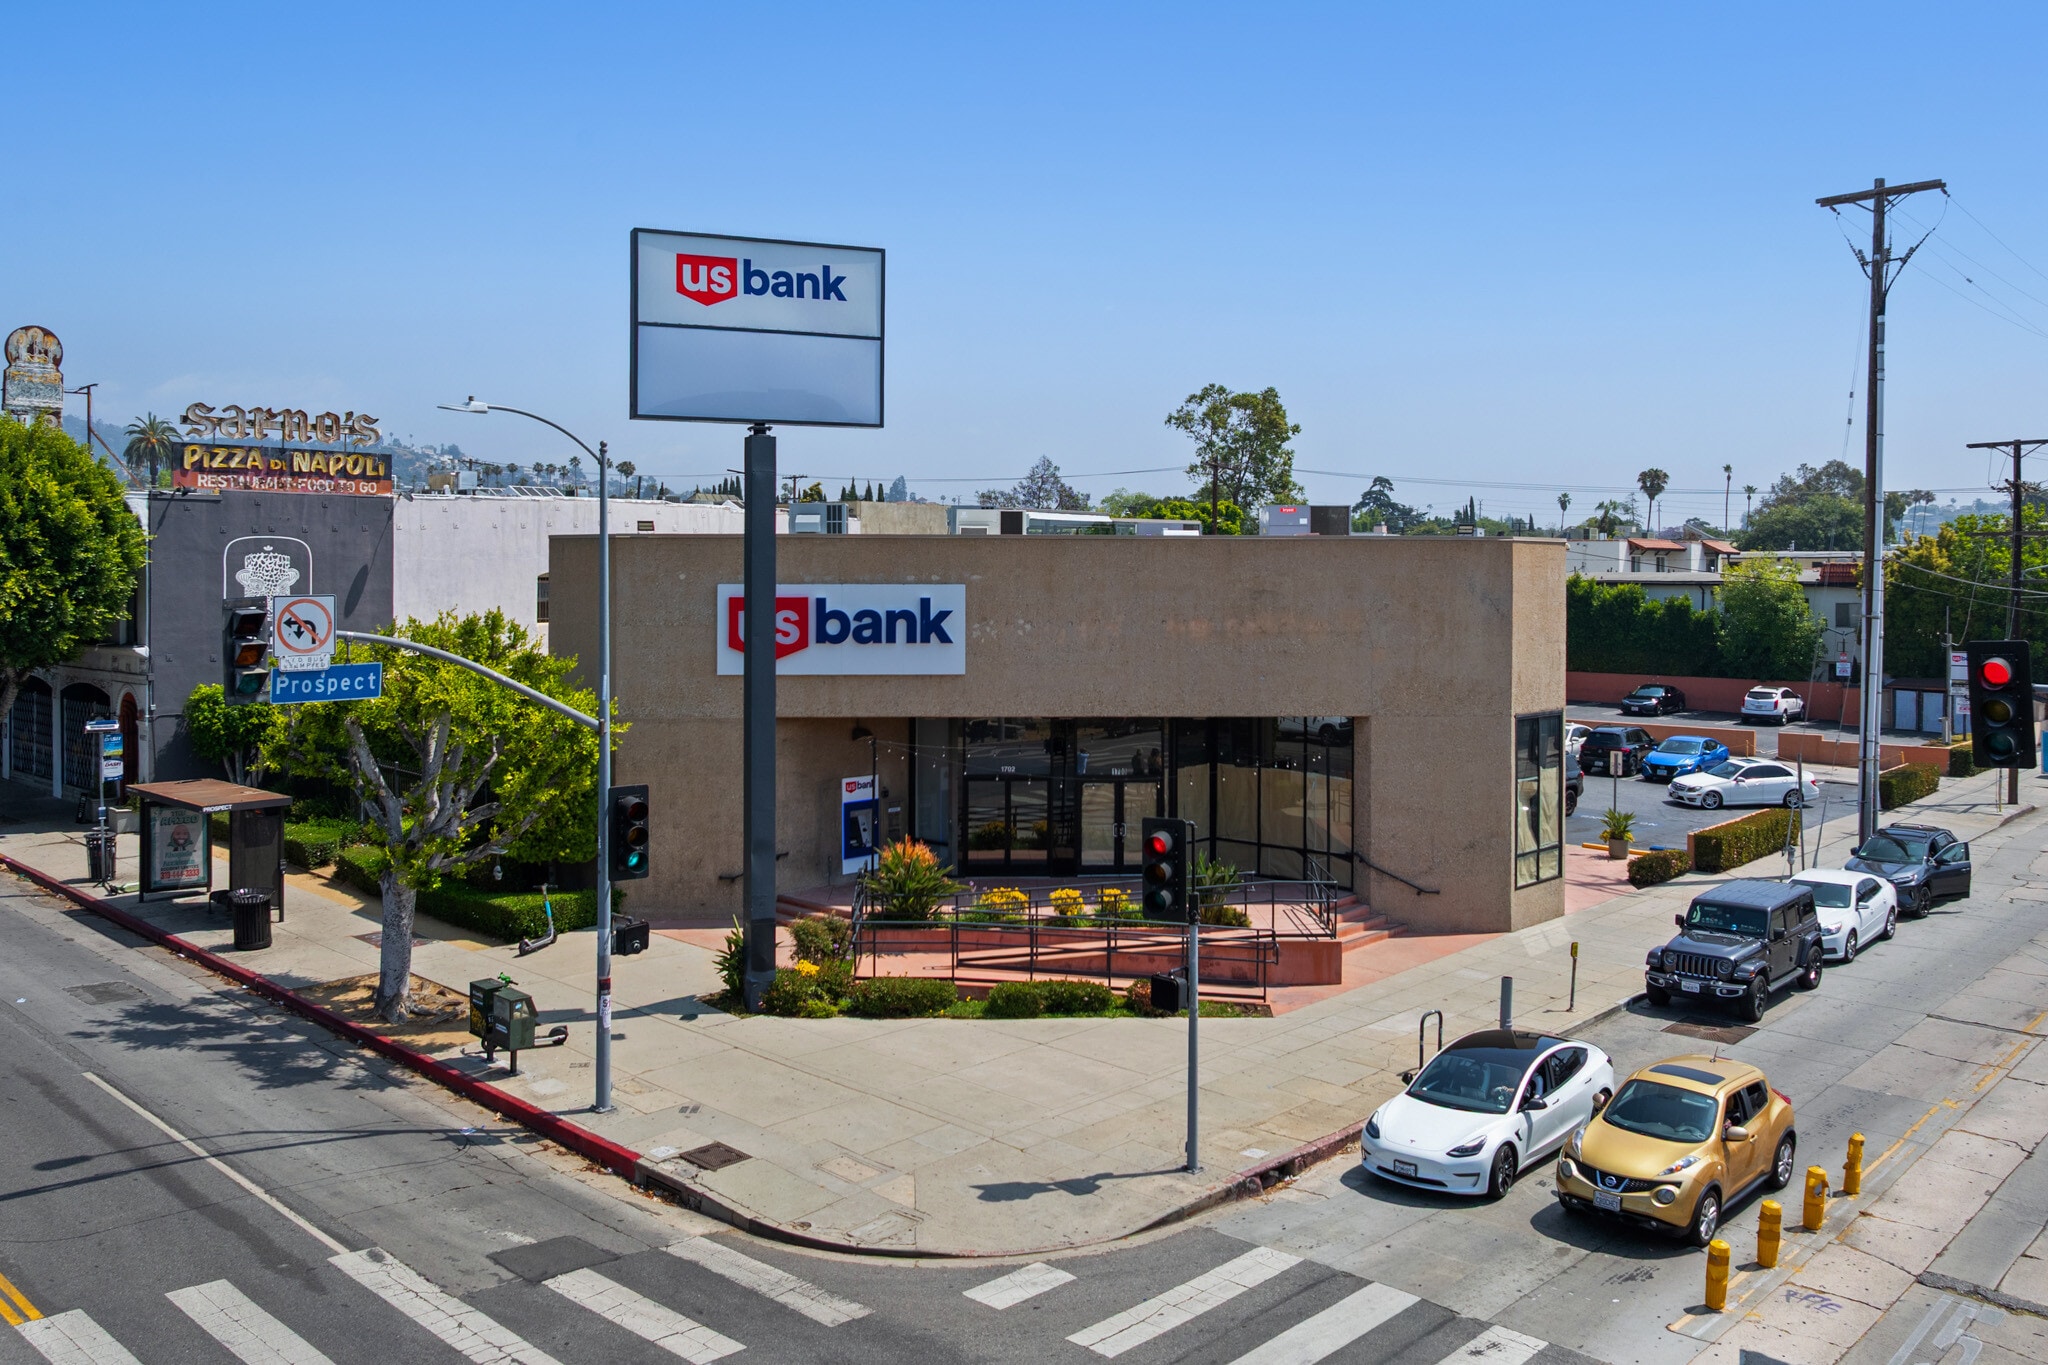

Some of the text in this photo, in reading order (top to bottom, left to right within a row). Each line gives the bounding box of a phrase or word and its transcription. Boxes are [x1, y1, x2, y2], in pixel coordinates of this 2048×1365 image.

[682, 259, 847, 301] us bank
[360, 481, 377, 493] GO
[815, 597, 954, 644] bank
[276, 672, 377, 696] Prospect
[202, 804, 233, 813] PROSPECT
